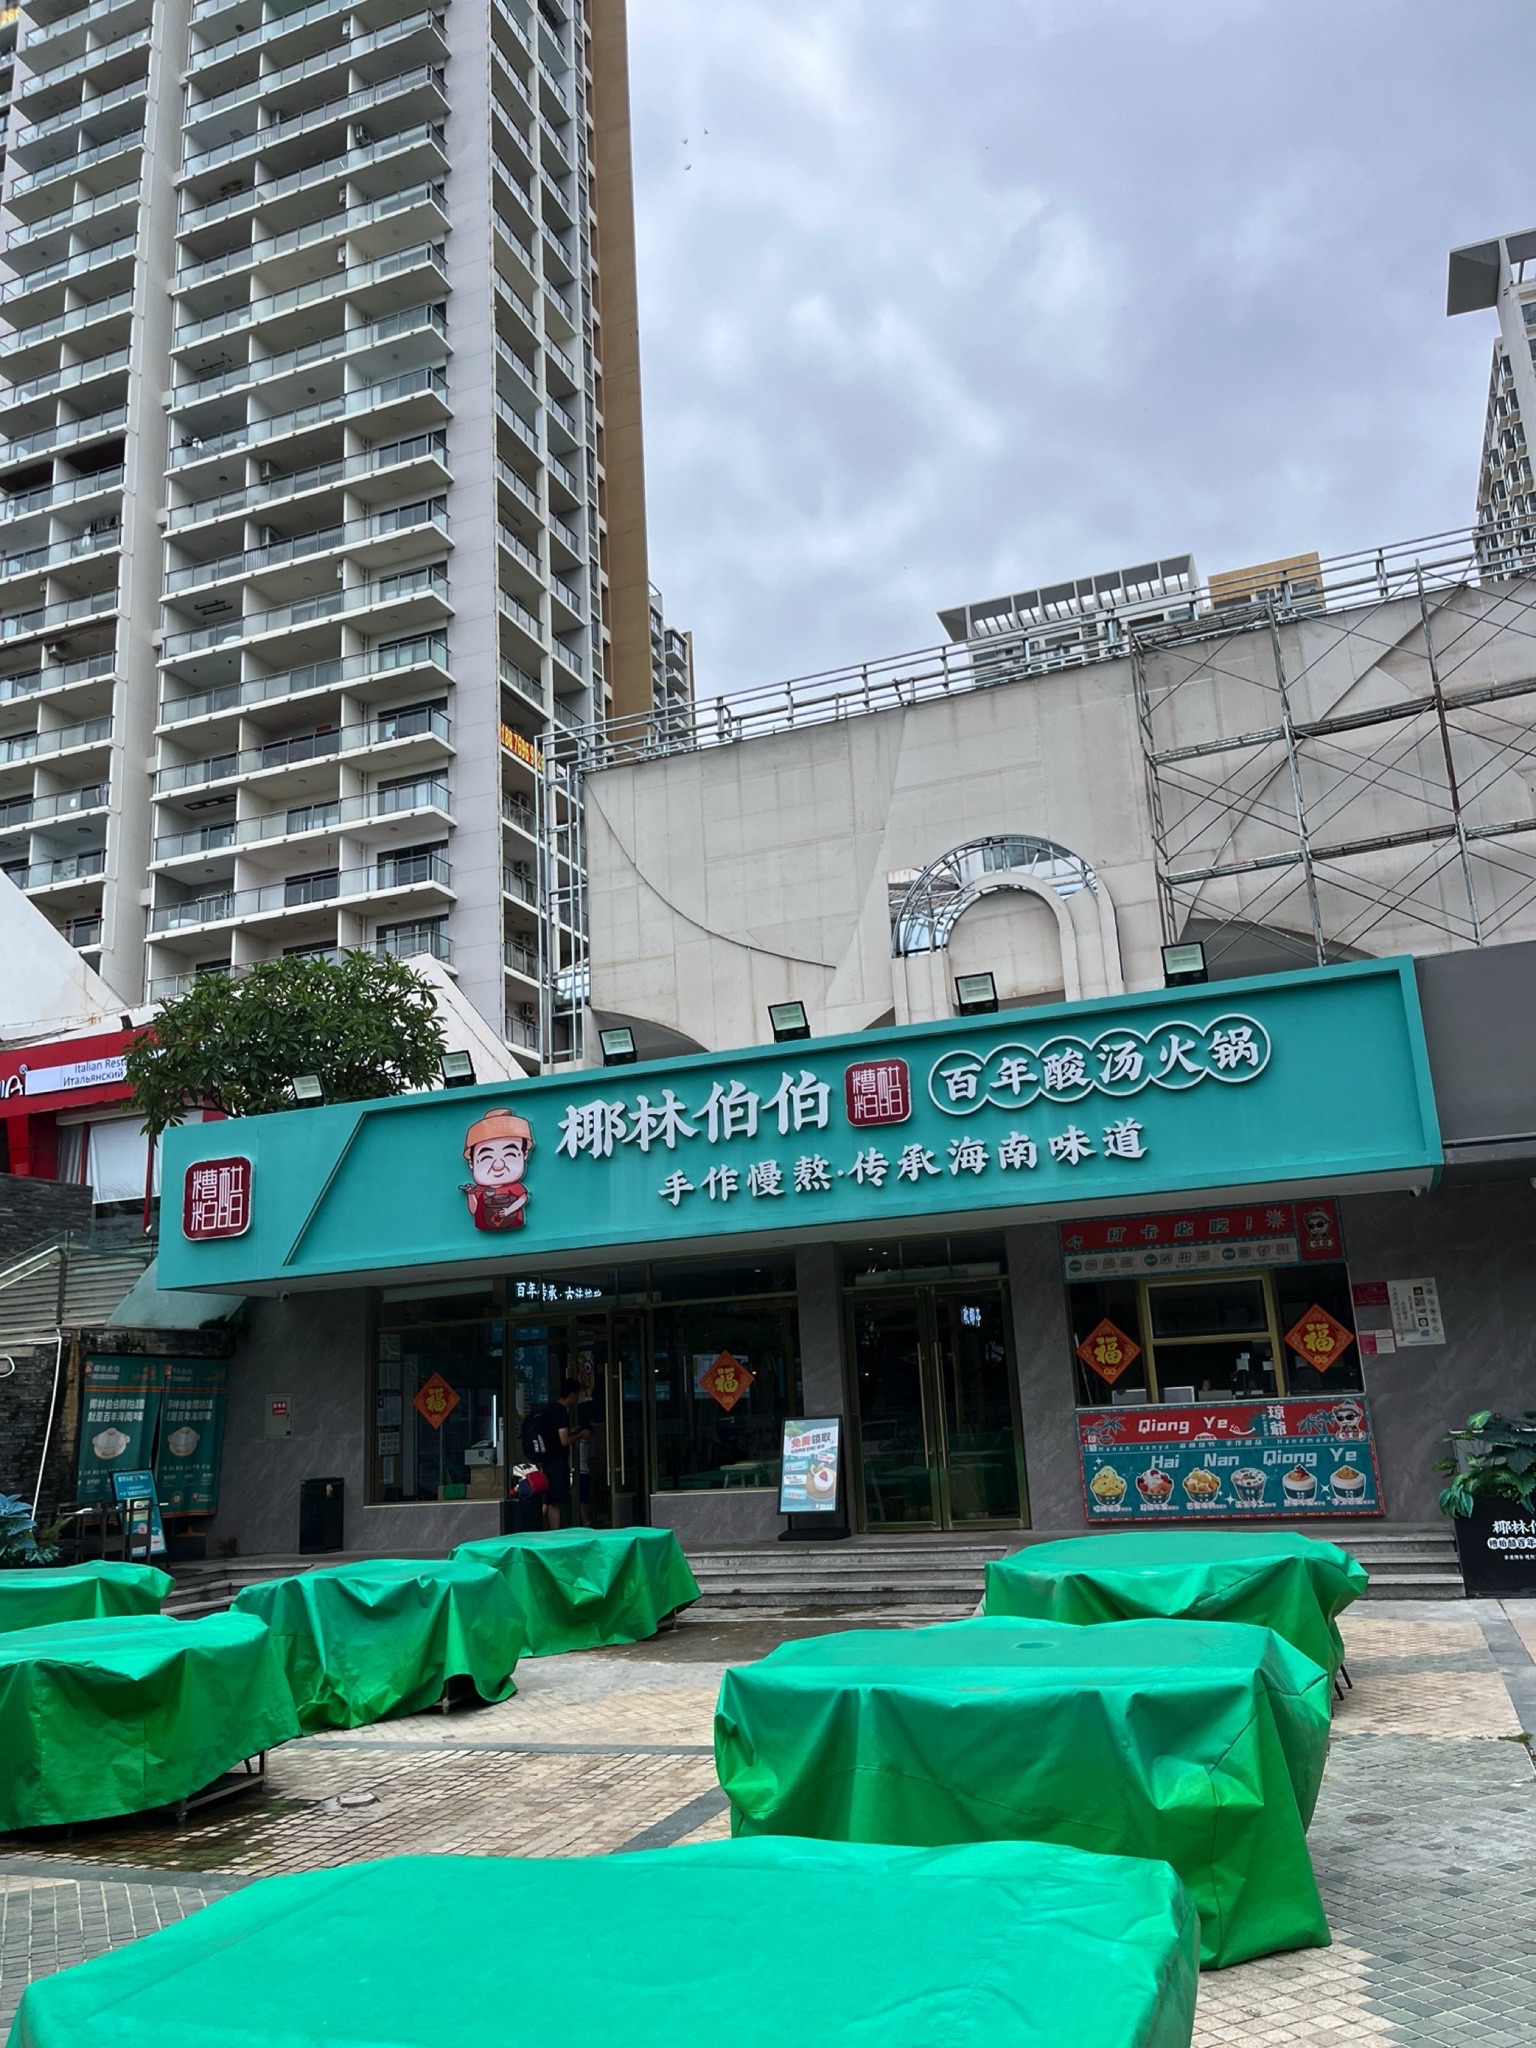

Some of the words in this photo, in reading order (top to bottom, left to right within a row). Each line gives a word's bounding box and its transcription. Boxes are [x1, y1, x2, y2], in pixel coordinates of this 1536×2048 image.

[75, 1061, 102, 1074] Italian
[939, 1025, 1260, 1103] 百年酸汤火锅
[63, 1068, 124, 1087] Итальянский
[555, 1069, 832, 1159] 椰林伯伯
[1303, 1323, 1335, 1352] 福
[1094, 1336, 1123, 1365] 福
[715, 1367, 739, 1393] 福
[425, 1387, 447, 1412] 福
[1137, 1418, 1190, 1434] Qiong
[1203, 1416, 1229, 1430] Ye
[1277, 1437, 1335, 1445] Handmade
[1150, 1454, 1180, 1470] Hai
[1203, 1452, 1240, 1467] Nan
[1262, 1450, 1318, 1467] Qiong
[1329, 1447, 1357, 1462] Ye
